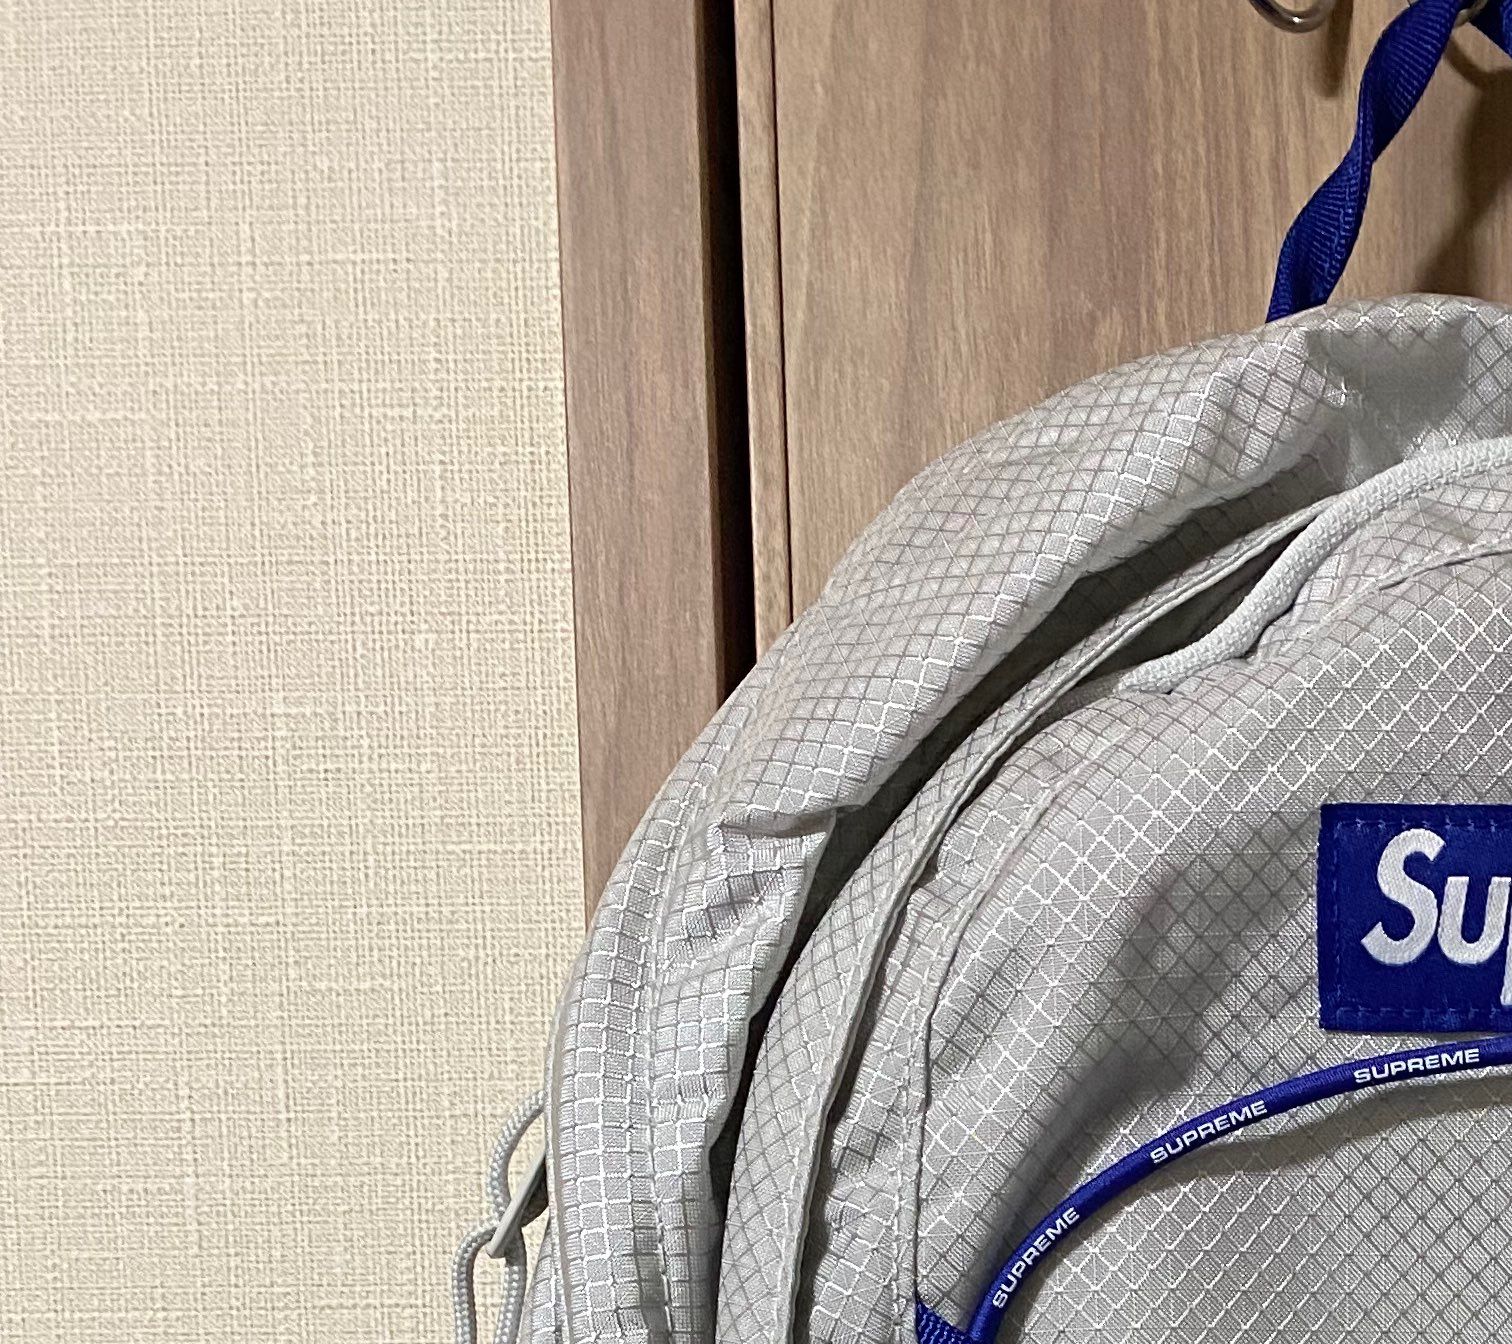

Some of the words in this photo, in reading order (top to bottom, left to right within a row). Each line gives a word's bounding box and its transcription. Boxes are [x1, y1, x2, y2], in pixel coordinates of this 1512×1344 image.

[1352, 1046, 1482, 1085] SUPREME
[1149, 1099, 1268, 1165] SUPREME
[991, 1206, 1081, 1310] SUPREME
